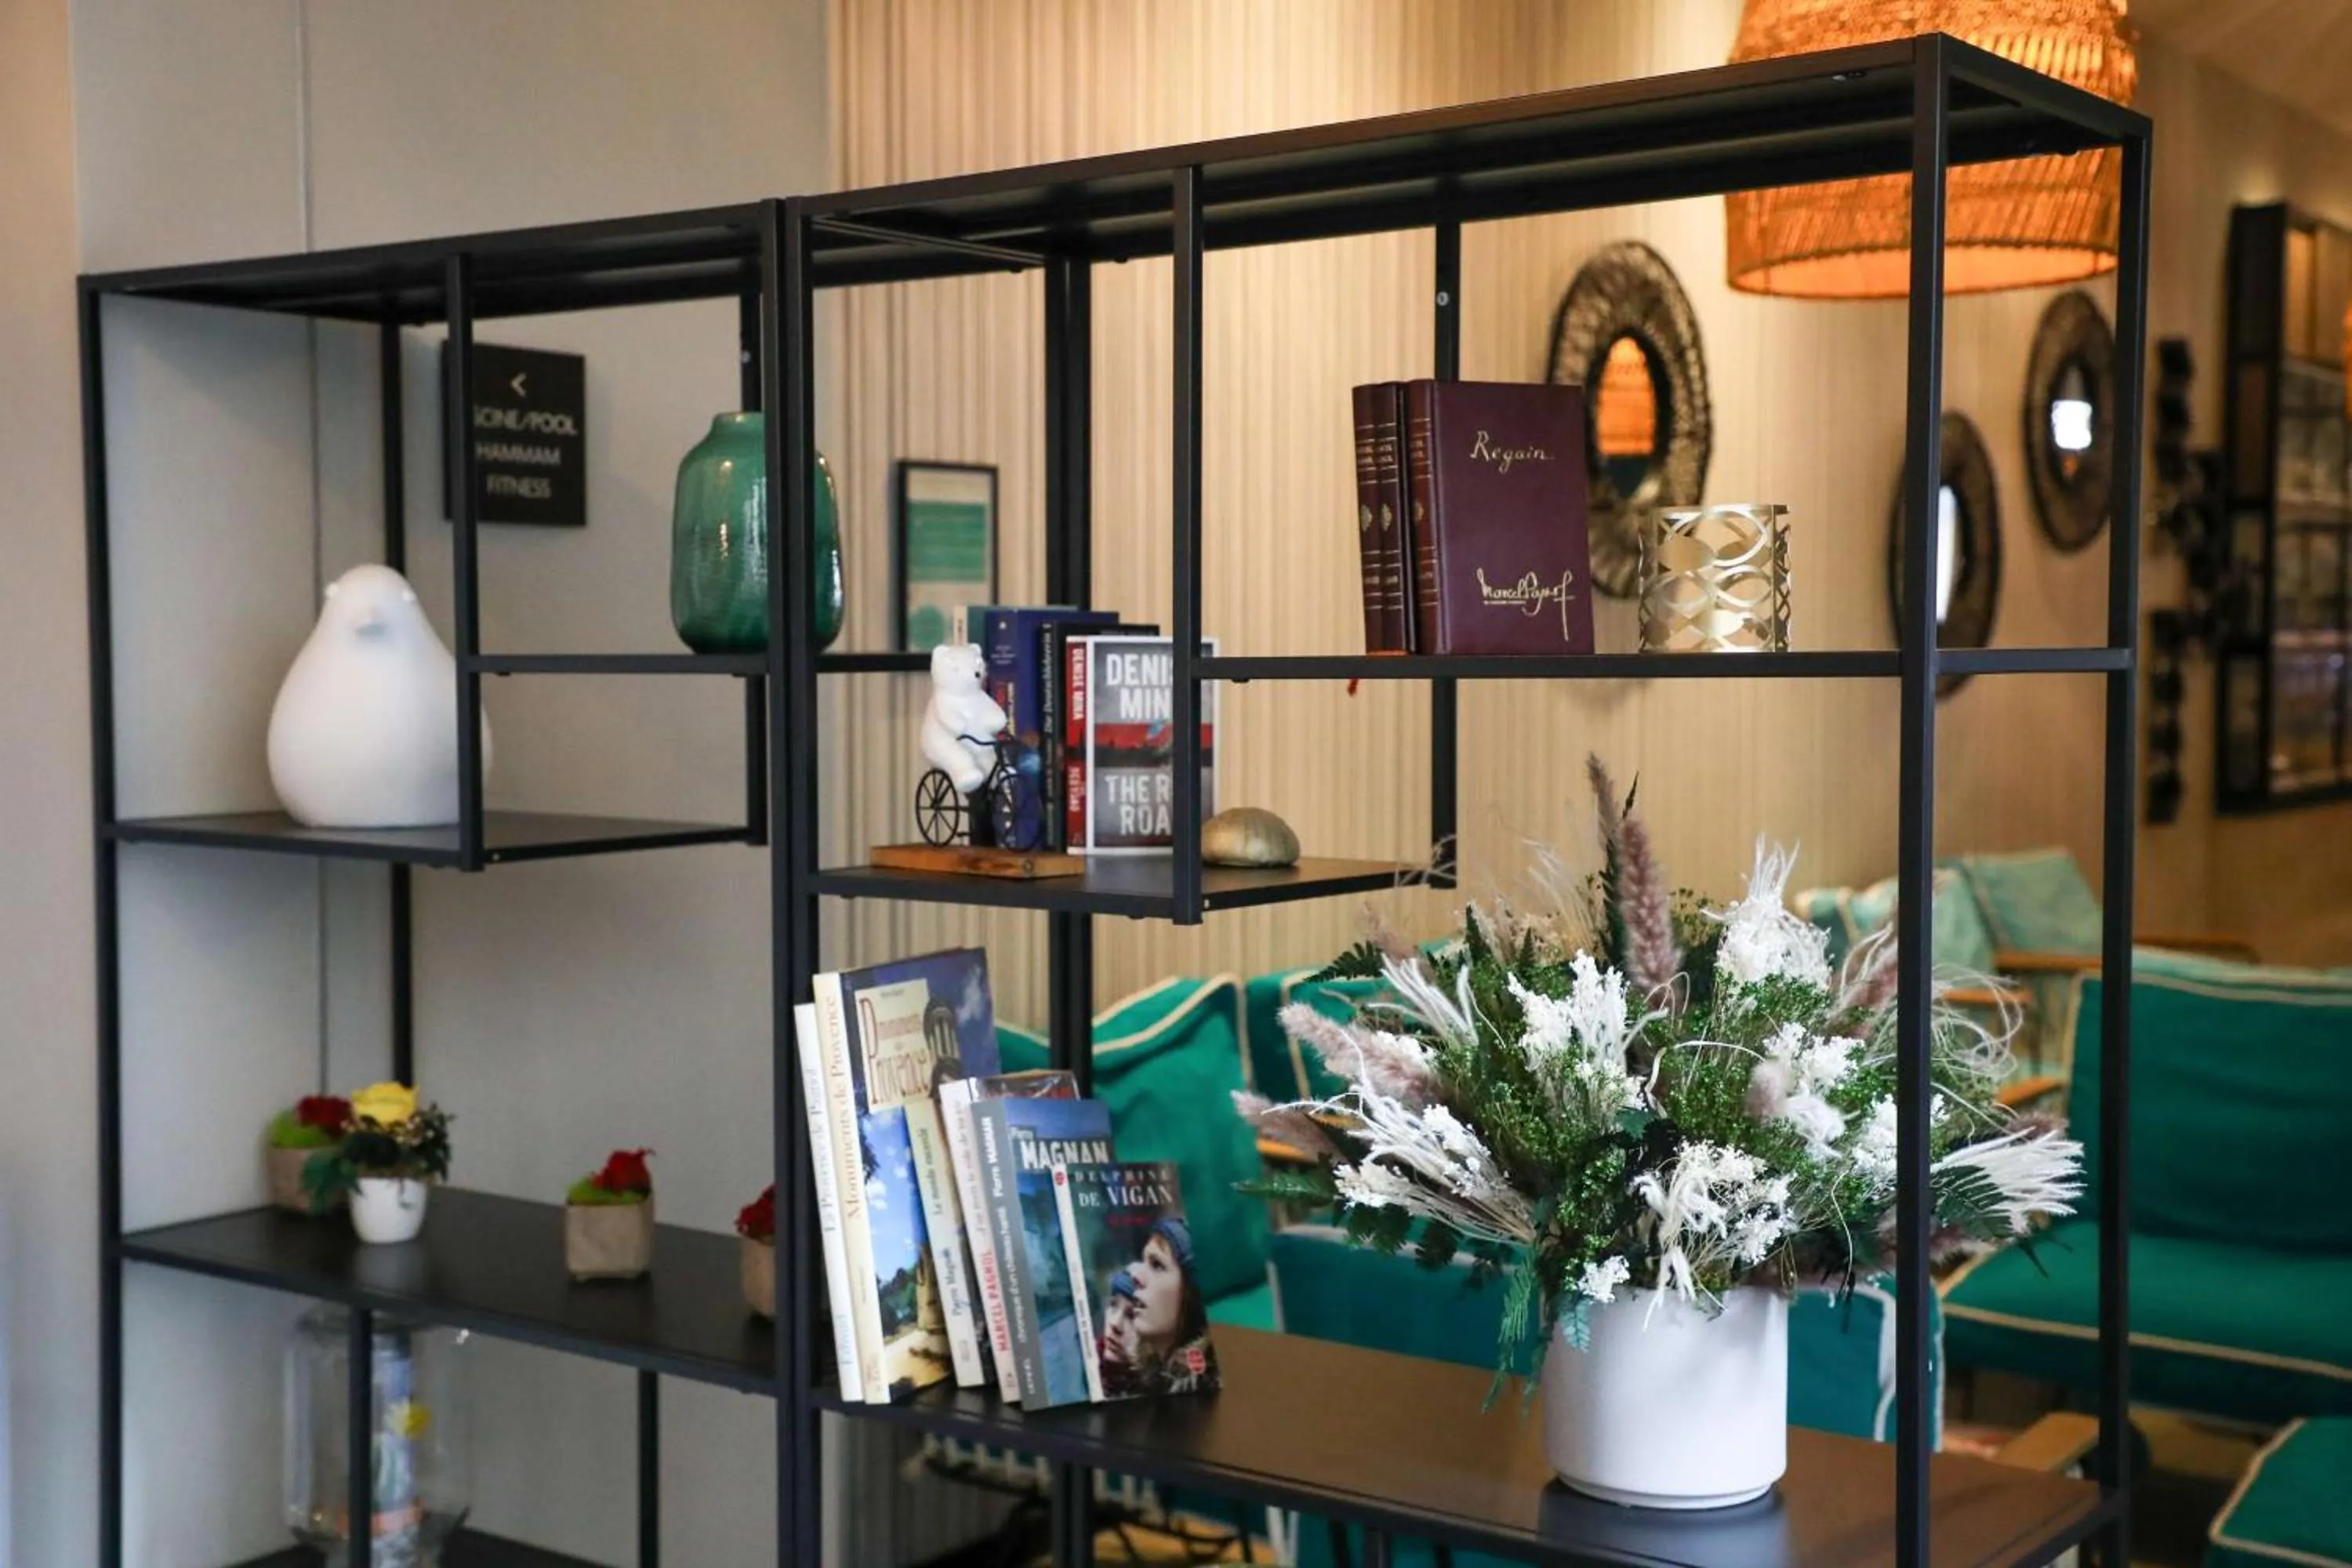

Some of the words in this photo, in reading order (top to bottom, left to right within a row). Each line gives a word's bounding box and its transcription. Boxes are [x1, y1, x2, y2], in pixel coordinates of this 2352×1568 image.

[475, 442, 561, 465] HAMMAM
[1470, 430, 1554, 474] Regain
[1105, 652, 1174, 687] DENI
[1120, 687, 1173, 720] MIN
[1105, 774, 1151, 804] THE
[1120, 804, 1173, 836] ROA
[826, 996, 844, 1077] Provence
[833, 1081, 847, 1105] de
[840, 1108, 860, 1218] Monuments
[1020, 1141, 1109, 1170] MAGNAN
[1079, 1192, 1100, 1207] DE
[1106, 1184, 1173, 1207] VIGAN
[980, 1248, 1000, 1301] PAGNOL
[991, 1303, 1008, 1352] MARCEL
